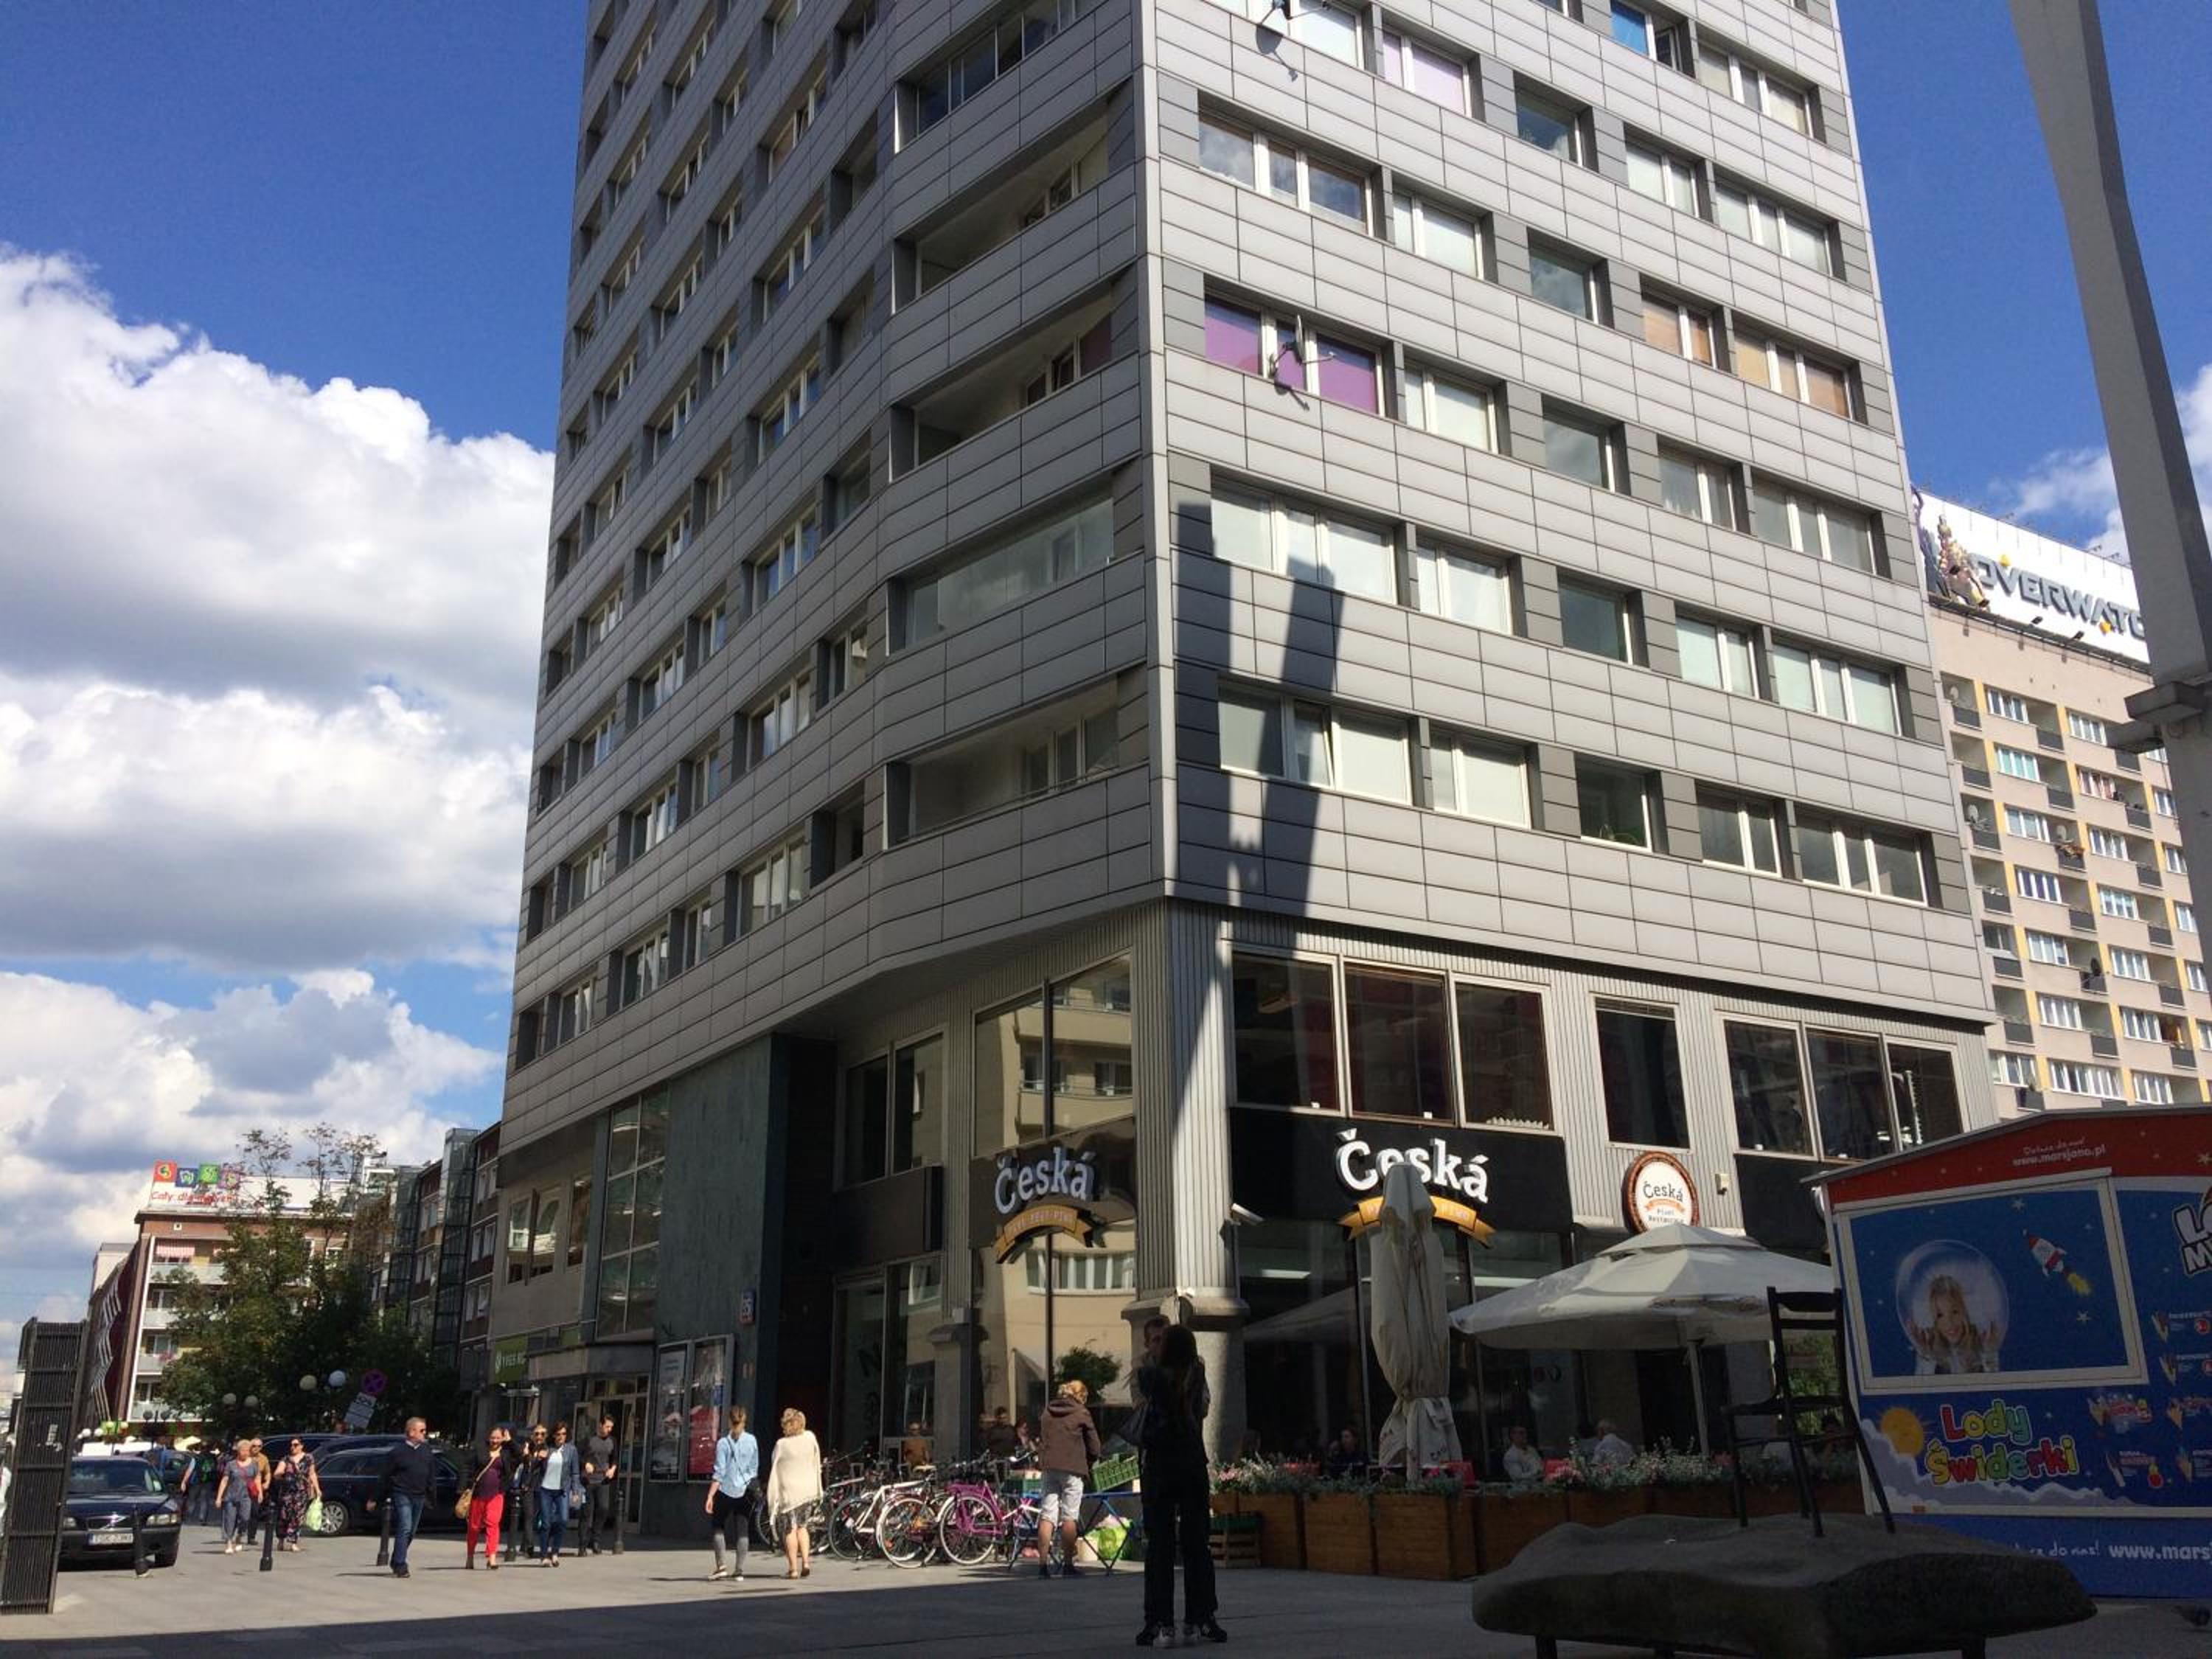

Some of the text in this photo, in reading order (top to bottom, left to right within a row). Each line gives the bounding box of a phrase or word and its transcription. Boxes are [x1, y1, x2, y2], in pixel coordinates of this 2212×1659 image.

[1972, 553, 2145, 640] OVERWATC
[995, 1147, 1096, 1214] Česká
[1337, 1127, 1489, 1203] Česká
[1643, 1180, 1683, 1203] Česká
[1940, 1399, 2032, 1445] Lody
[1924, 1435, 2080, 1486] Świderki
